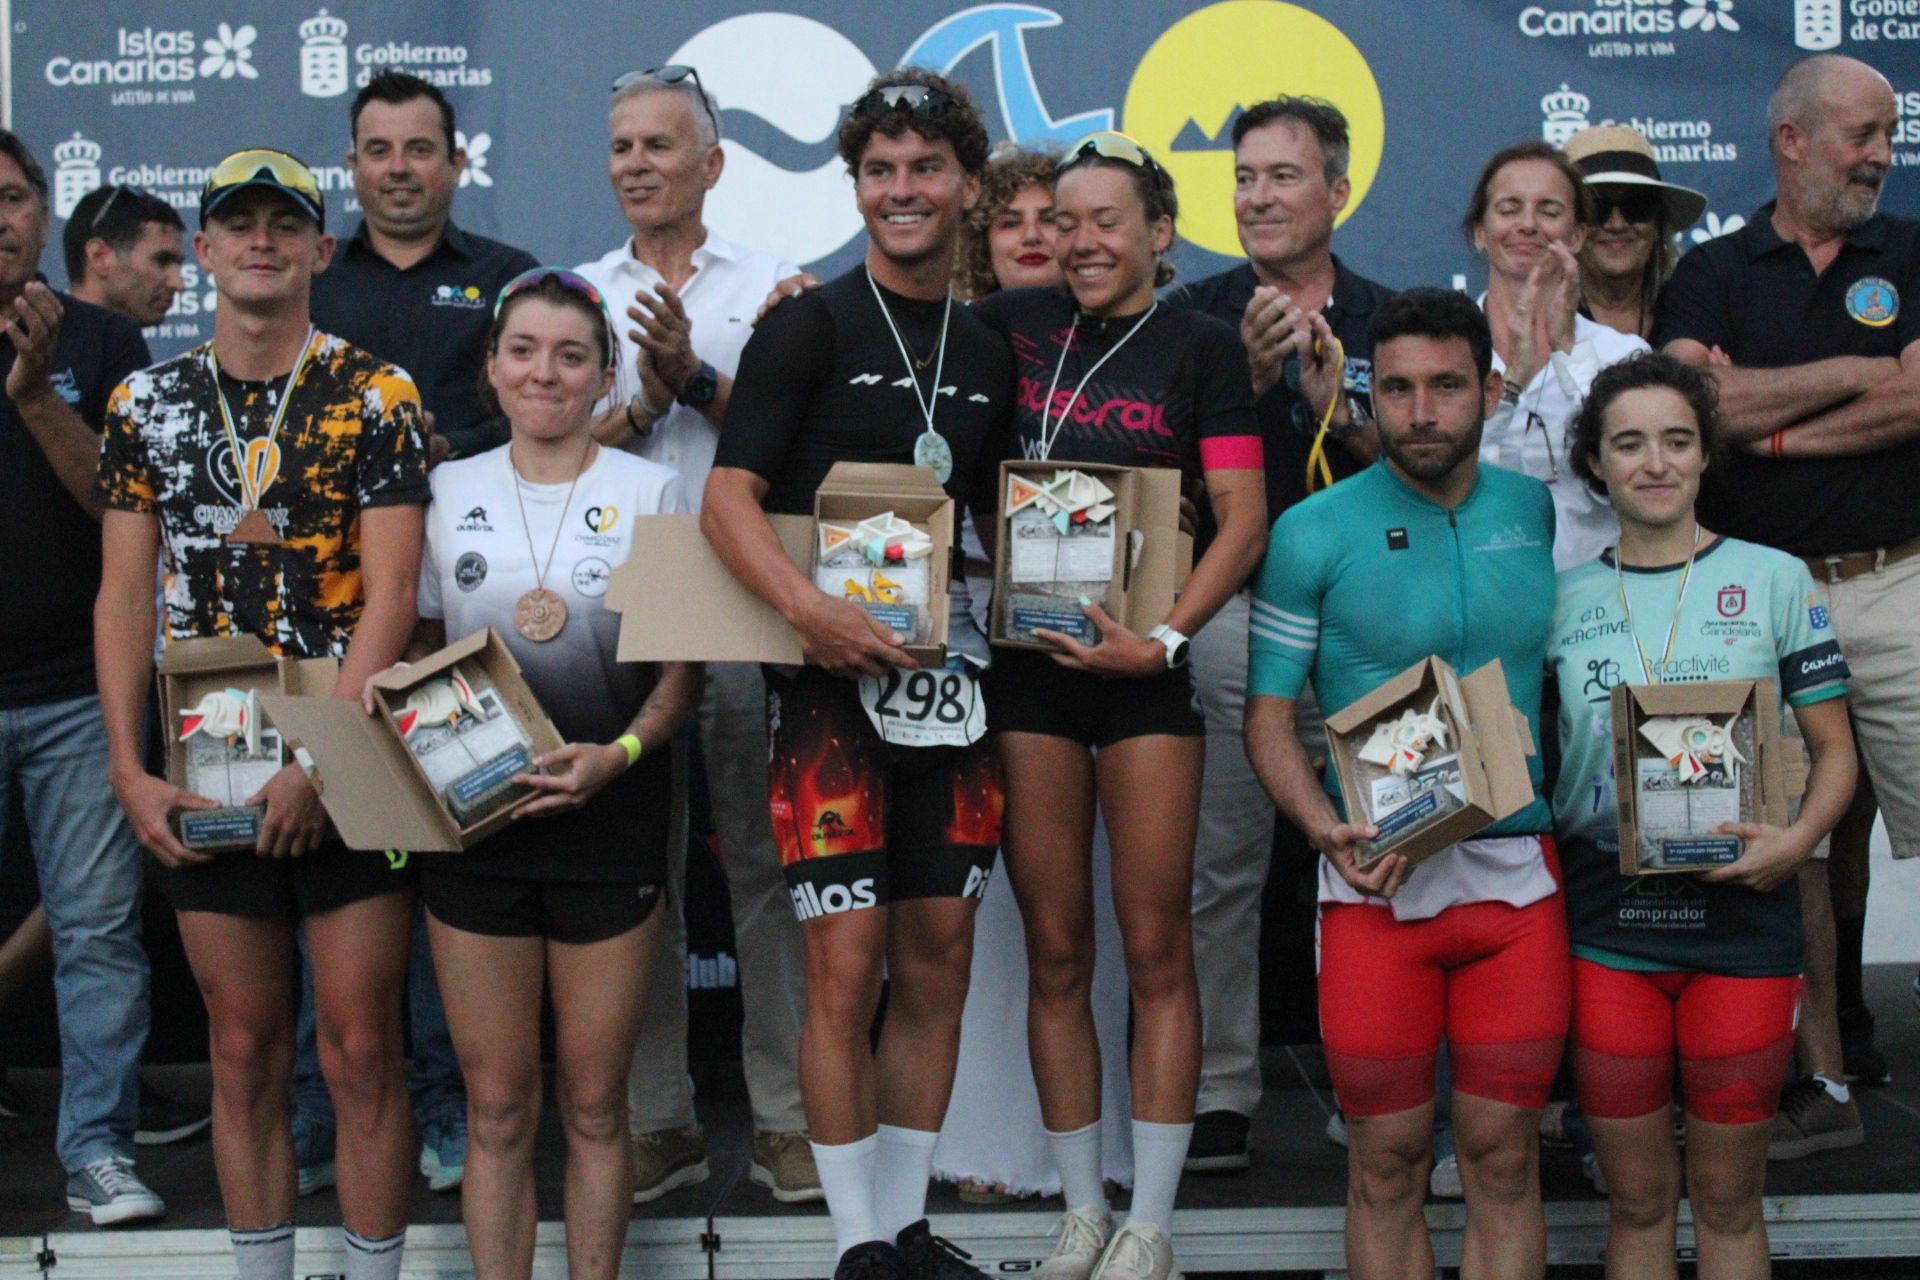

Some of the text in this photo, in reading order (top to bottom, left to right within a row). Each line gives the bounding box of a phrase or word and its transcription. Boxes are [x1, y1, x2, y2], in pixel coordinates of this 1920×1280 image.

[1850, 0, 1920, 16] Gobie
[1519, 6, 1675, 37] Canarias
[1850, 18, 1879, 40] de
[118, 27, 195, 56] Islas
[355, 42, 468, 64] Gobierno
[45, 55, 195, 86] Canarias
[391, 65, 492, 87] narias
[1600, 117, 1711, 139] bierno
[1651, 140, 1737, 161] anarias
[875, 667, 966, 723] 298
[1619, 906, 1706, 922] comprador
